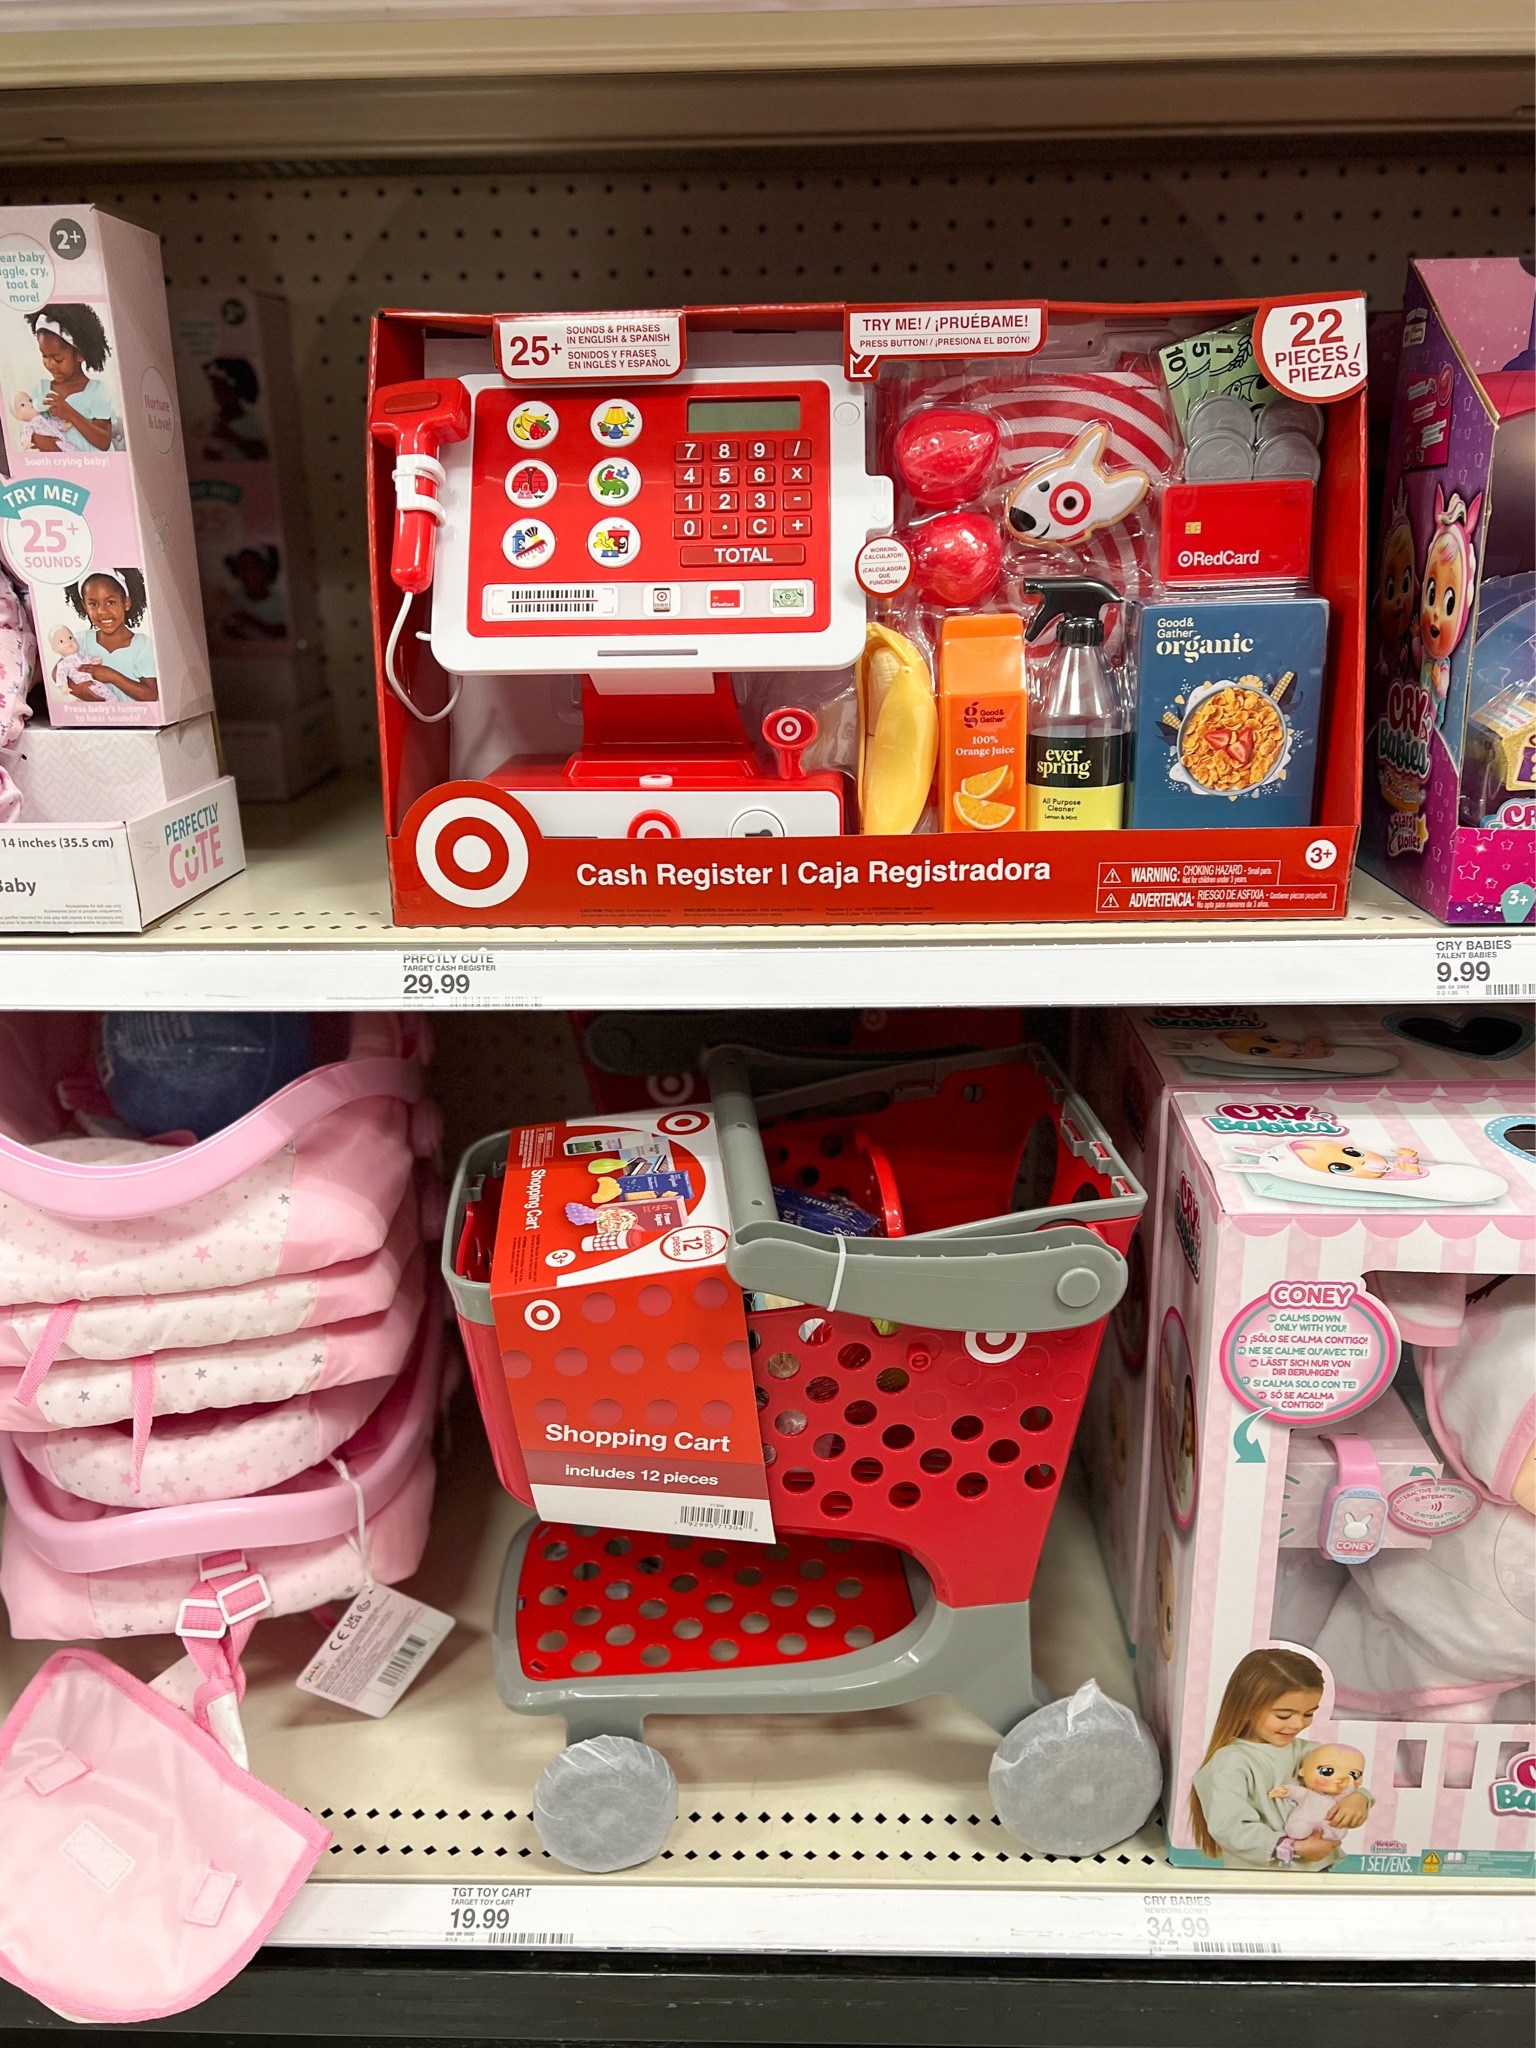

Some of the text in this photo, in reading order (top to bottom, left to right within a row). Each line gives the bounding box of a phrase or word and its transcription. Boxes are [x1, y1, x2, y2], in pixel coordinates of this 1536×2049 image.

[56, 230, 80, 249] 2+
[0, 252, 45, 264] ear baby
[30, 267, 48, 277] cry,
[6, 279, 39, 289] toot &
[9, 292, 39, 302] more!
[566, 324, 660, 334] SOUNDS & PHRASES
[863, 313, 1028, 332] TRY ME! / ¡PRUÉBAME!
[1290, 308, 1344, 348] 22
[566, 335, 576, 344] IN
[579, 335, 618, 344] ENGLISH
[629, 334, 670, 342] SPANISH
[860, 334, 1030, 348] PRESS BUTTON! / ¡PRESIONA EL BOTÓN!
[509, 335, 562, 366] 25+
[568, 349, 657, 359] SONIDOS Y FRASES
[1192, 342, 1210, 358] 5
[1275, 343, 1361, 367] PIECES /
[568, 361, 581, 369] EN
[583, 357, 616, 369] INGLÉS
[628, 357, 671, 367] ESPAÑOL
[1165, 346, 1187, 372] 10
[1288, 362, 1361, 384] PIEZAS
[684, 442, 766, 459] 7 8 9
[24, 457, 110, 468] Sooth crying baby!
[683, 467, 766, 483] 4 5 6
[3, 484, 79, 508] TRY ME!
[684, 493, 766, 510] 1 2 3
[683, 518, 767, 536] 0 C
[20, 519, 79, 553] 25+
[24, 556, 82, 568] SOUNDS
[714, 547, 774, 563] TOTAL
[1193, 550, 1260, 566] RedCard
[1157, 617, 1194, 628] Good&
[1157, 629, 1193, 639] Gather
[1156, 632, 1254, 664] organic
[64, 704, 148, 715] Press baby's tummy
[980, 708, 1004, 716] Good&
[1389, 685, 1428, 736] CRY
[86, 714, 106, 722] hear
[108, 714, 140, 722] sounds!
[980, 716, 1004, 724] Gather
[972, 735, 998, 744] 100%
[955, 745, 1015, 757] Orange Juice
[1045, 749, 1083, 763] ever
[1380, 720, 1429, 776] Babies
[1036, 760, 1091, 780] spring
[1052, 799, 1081, 807] Purpose
[164, 802, 219, 845] PERFECTLY
[1, 837, 114, 849] 14 inches (35.5 cm)
[1309, 847, 1333, 864] 3+
[576, 858, 1051, 891] Cash Register Caja Registradora
[1131, 864, 1243, 883] WARNING: CHOKING HAZARD
[1129, 889, 1264, 908] ADVERTENCIA: RIESGO DE ASFIXIA
[1508, 890, 1529, 906] 3+
[1436, 939, 1512, 951] CRY BABIES
[403, 953, 494, 963] PRFCTLY CUTE
[1437, 961, 1491, 983] 9.99
[403, 974, 470, 994] 29.99
[1222, 1104, 1312, 1121] CRY
[1208, 1117, 1342, 1133] Babies
[524, 1169, 547, 1210] Shopping
[524, 1210, 543, 1231] Cart
[670, 1236, 682, 1257] pieces
[683, 1236, 703, 1252] 12
[703, 1229, 714, 1255] includes
[551, 1251, 569, 1265] 3+
[1274, 1286, 1351, 1304] CONEY
[1280, 1314, 1311, 1322] CALMS
[1299, 1324, 1323, 1332] WITH
[1250, 1333, 1276, 1344] ¡SÓLO
[1279, 1335, 1289, 1343] SE
[1324, 1337, 1368, 1345] CONTIGO!
[545, 1423, 731, 1452] Shopping Cart
[565, 1464, 719, 1486] includes 12 pieces
[1336, 1541, 1375, 1551] CONEY
[1360, 1855, 1413, 1873] 1 SET/ENS.
[452, 1887, 532, 1898] TGT TOY CART
[1143, 1895, 1212, 1906] CRY BABIES
[450, 1908, 510, 1929] 19.99
[1147, 1916, 1210, 1939] 34.99
